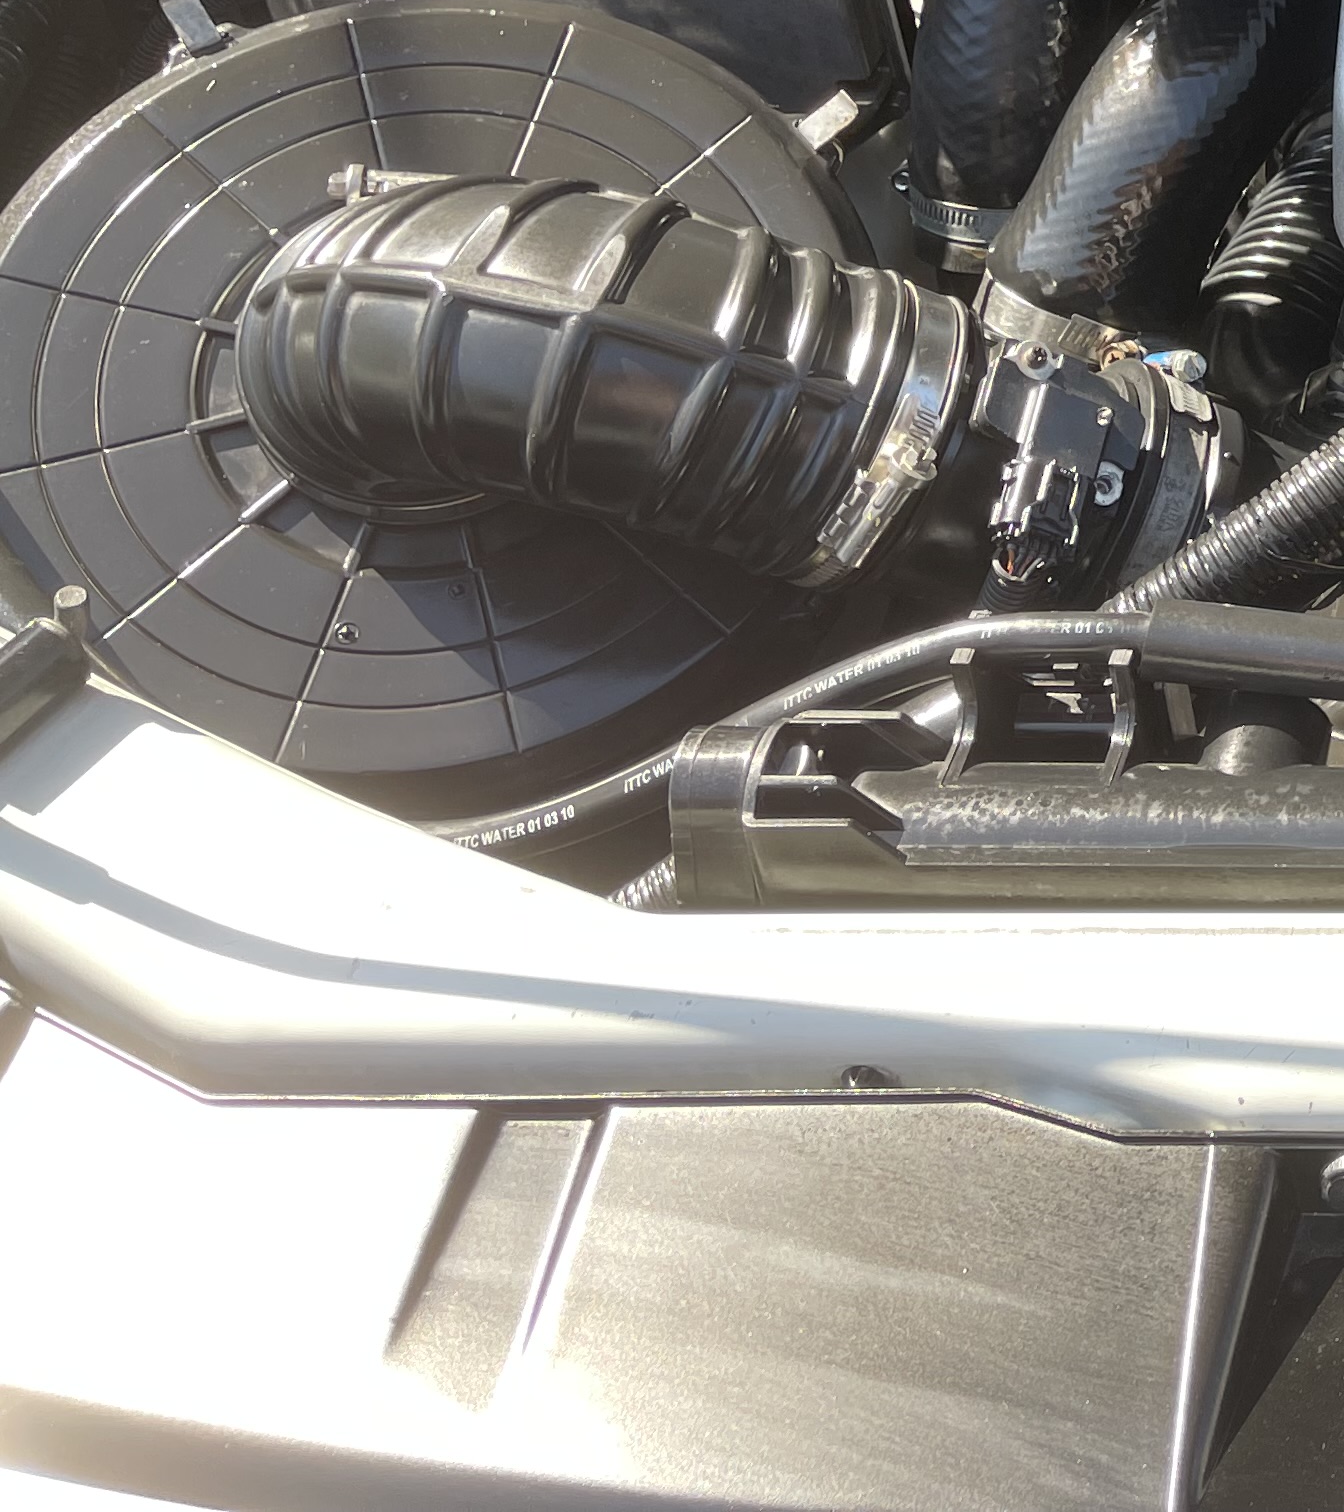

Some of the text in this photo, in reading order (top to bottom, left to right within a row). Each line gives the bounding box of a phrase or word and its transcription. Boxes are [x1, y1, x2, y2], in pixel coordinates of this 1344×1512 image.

[623, 769, 651, 794] ITTC
[480, 821, 525, 847] WATER
[527, 818, 542, 833] 01
[544, 811, 559, 829] 03
[560, 804, 575, 821] 10
